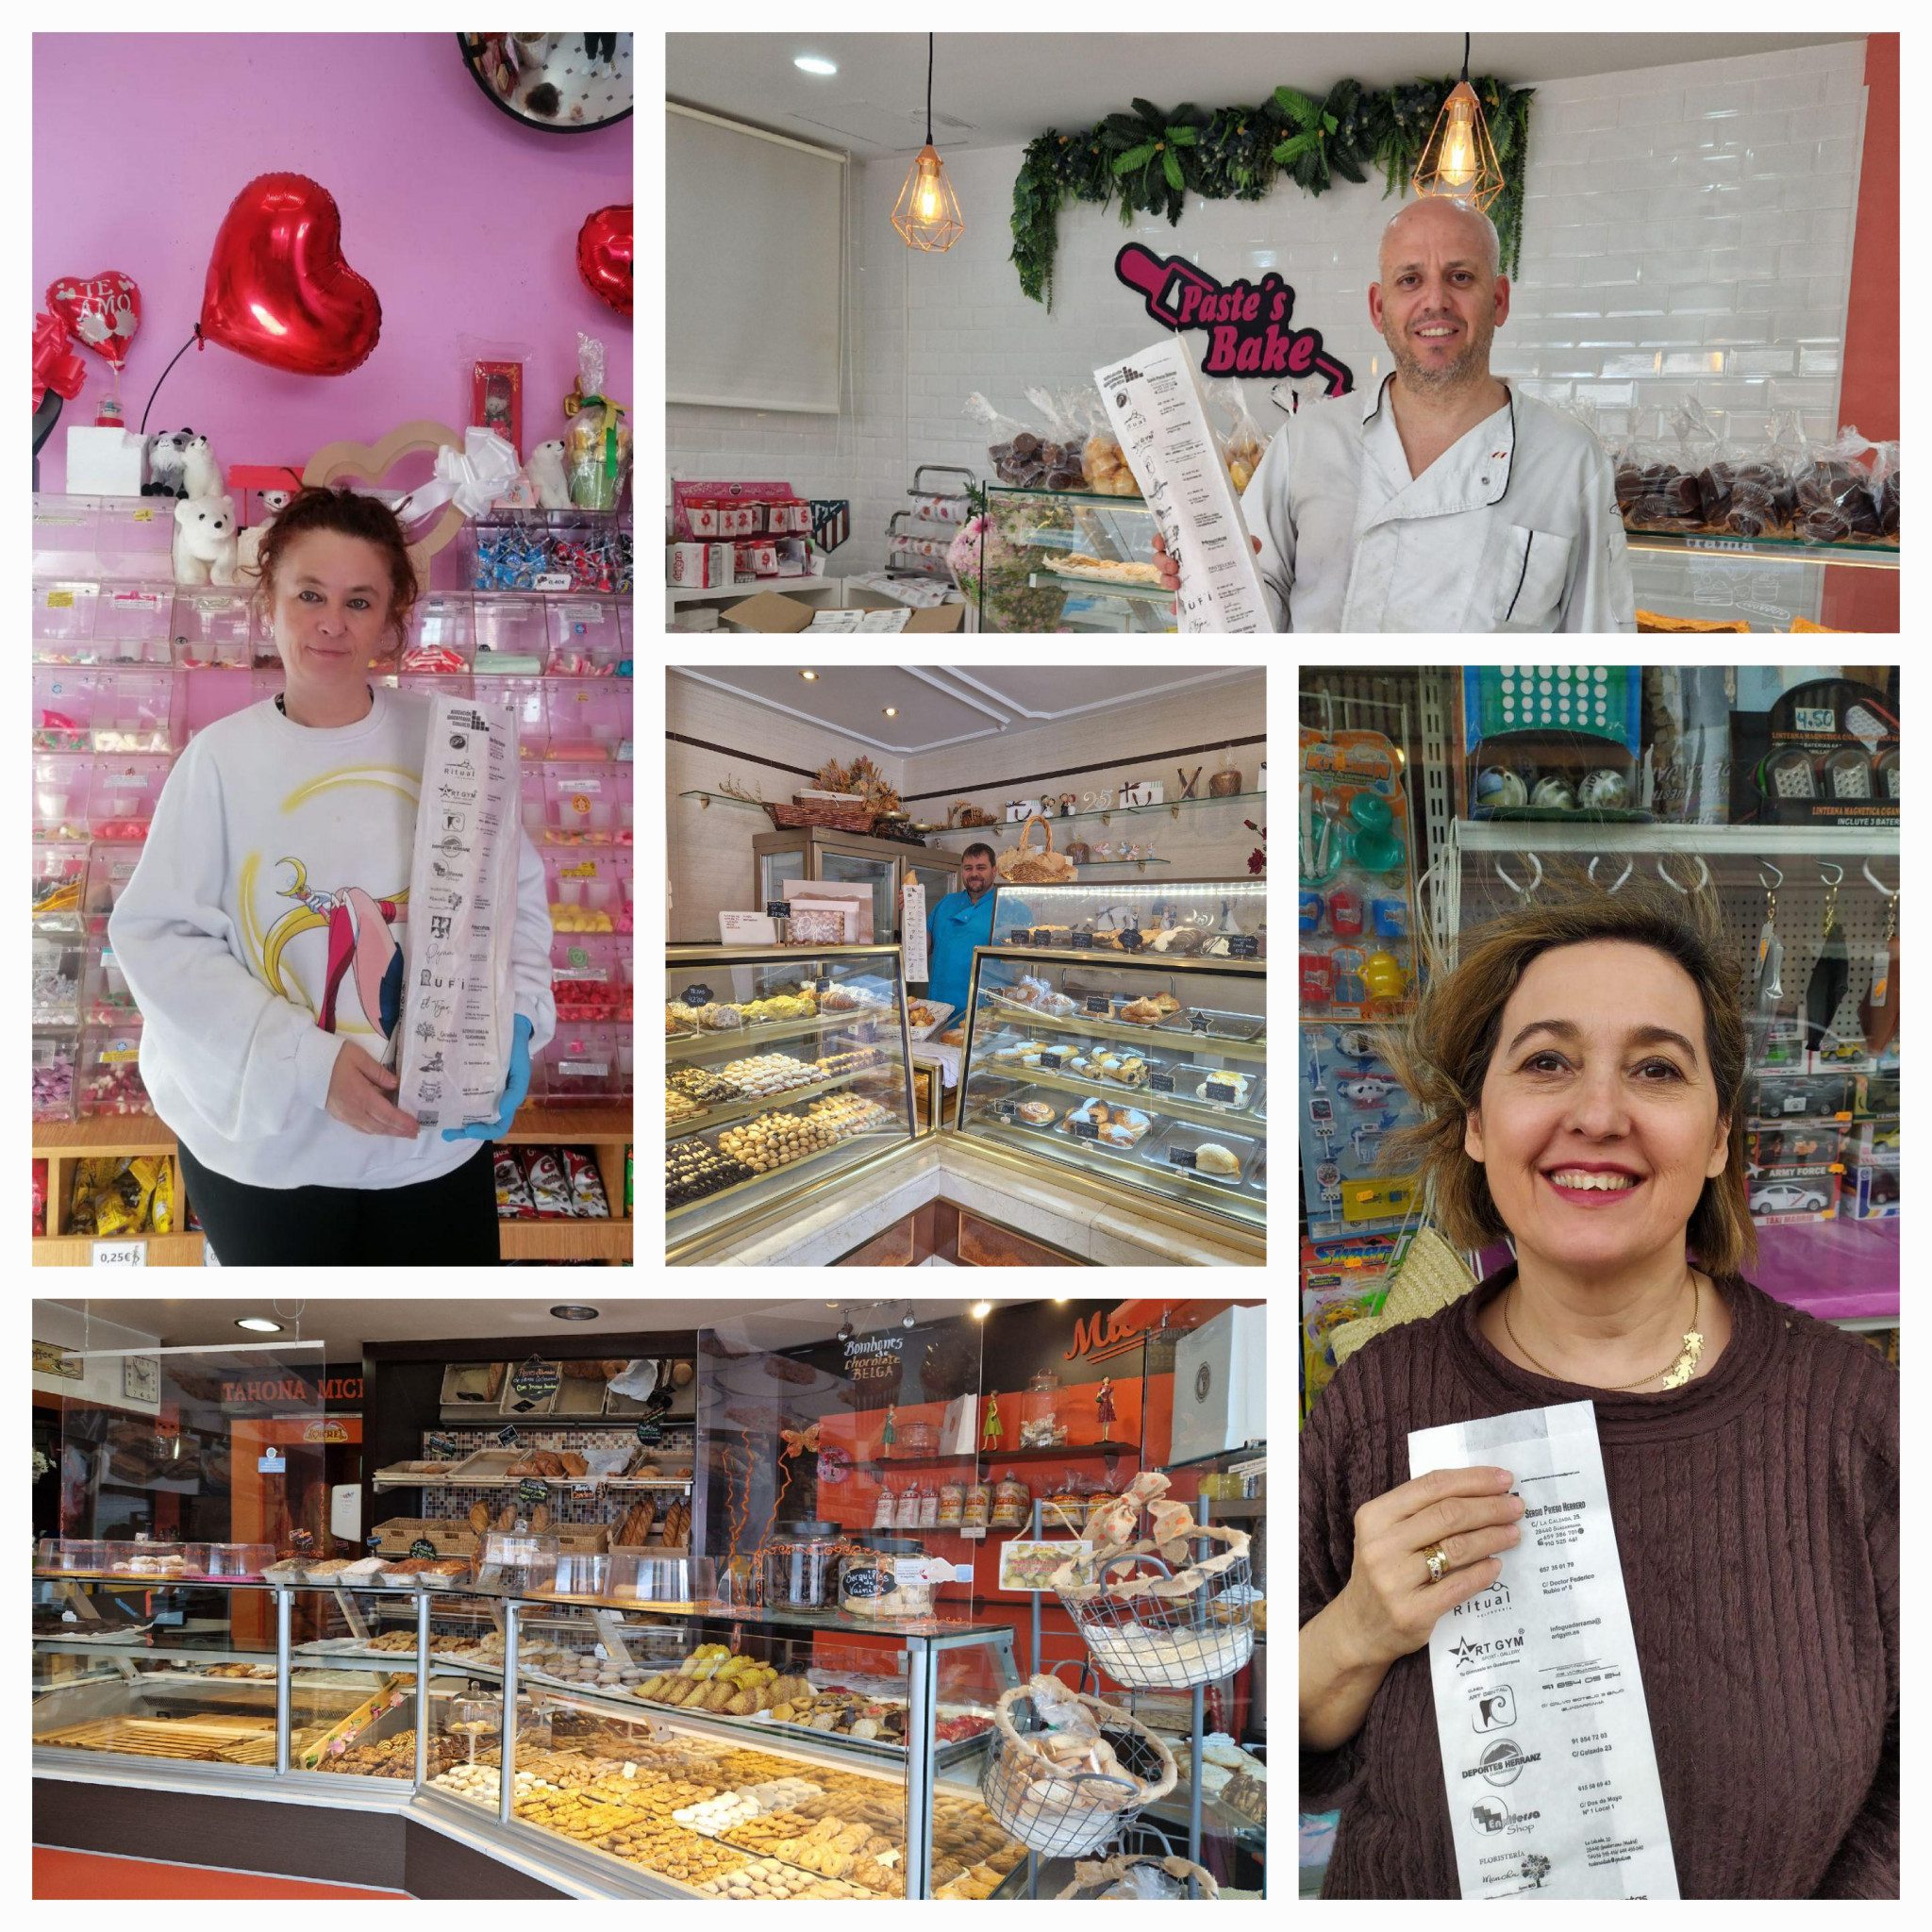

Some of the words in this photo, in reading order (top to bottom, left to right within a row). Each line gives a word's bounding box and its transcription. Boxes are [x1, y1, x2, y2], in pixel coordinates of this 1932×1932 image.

[79, 279, 113, 297] TE
[76, 294, 131, 322] AMO
[1207, 325, 1314, 372] Bake
[1796, 709, 1833, 728] 4.50
[443, 767, 475, 777] Ritual
[1812, 807, 1842, 815] LINTERNA
[1837, 818, 1869, 826] INCLUYE
[1769, 1169, 1794, 1177] ARMY
[1797, 1166, 1826, 1174] FORCE
[101, 1254, 131, 1263] 0,25€
[844, 1336, 904, 1357] Bombones
[851, 1366, 893, 1380] BELGA
[222, 1379, 307, 1403] TAHONA
[1570, 1574, 1594, 1582] Federico
[1454, 1591, 1510, 1616] Ritual
[1495, 1636, 1524, 1650] GYM
[1461, 1761, 1504, 1779] DEPORTES
[1505, 1752, 1541, 1769] HERRANZ
[1507, 1824, 1535, 1836] Shop
[1479, 1850, 1525, 1865] FLORISTERÍA
